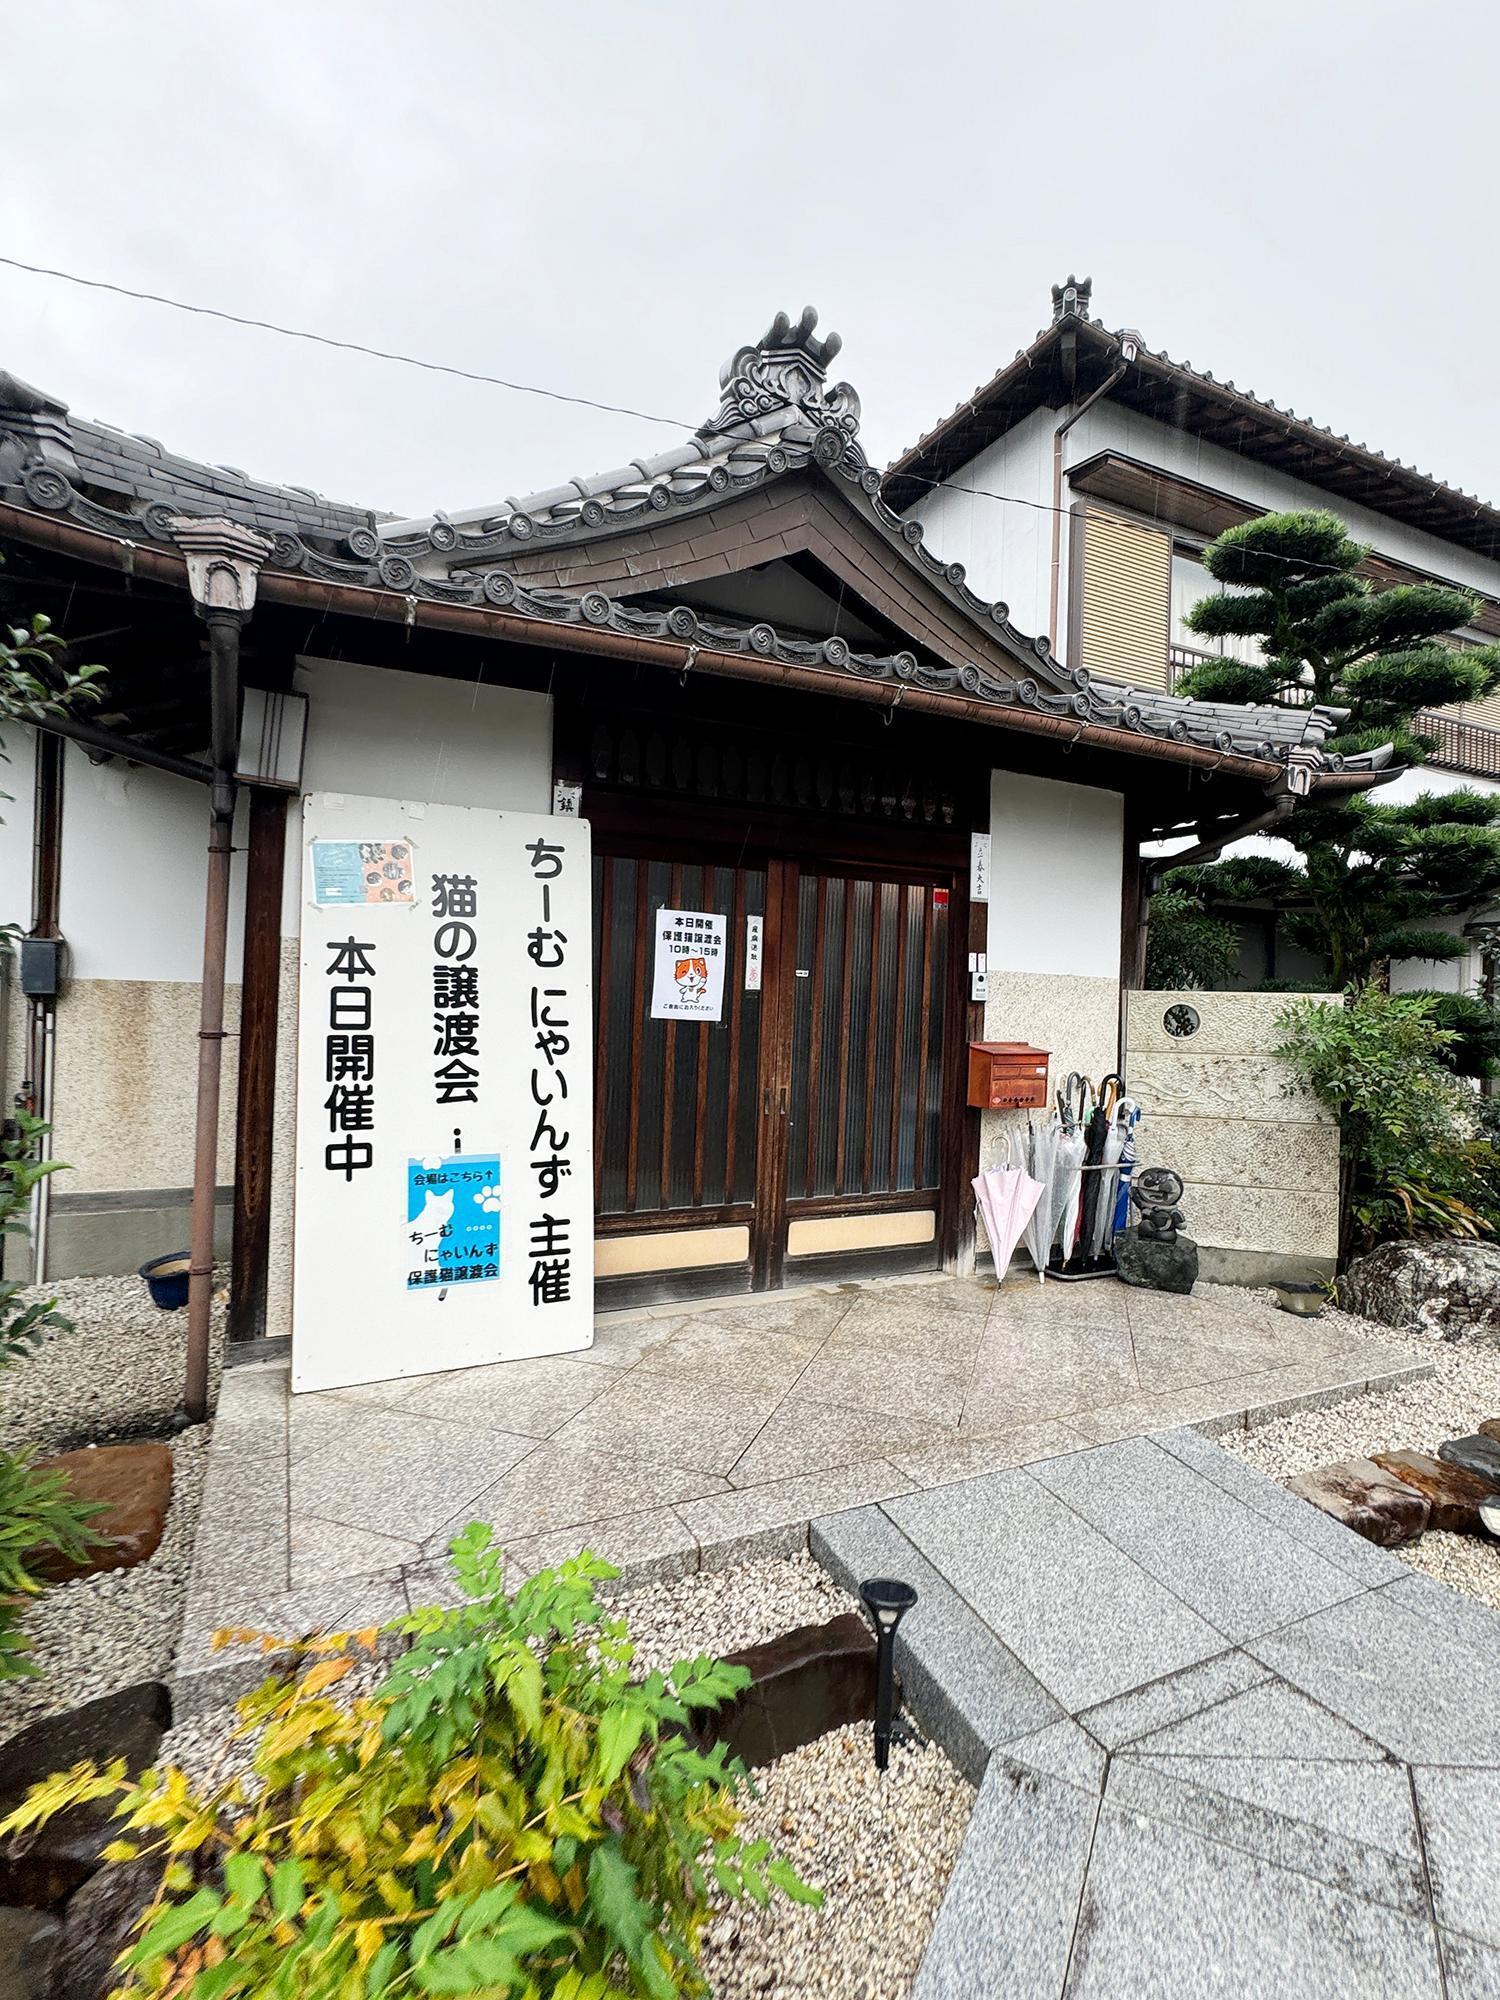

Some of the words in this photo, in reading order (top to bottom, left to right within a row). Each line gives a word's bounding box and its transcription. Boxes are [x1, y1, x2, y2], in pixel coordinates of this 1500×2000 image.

[525, 837, 568, 968] ちーむ
[674, 916, 713, 930] 本日開催
[662, 930, 722, 946] 保護猫譲渡会
[431, 874, 480, 1104] 猫の譲渡会
[323, 935, 377, 1183] 本日開催中
[529, 986, 572, 1199] にゃいんず
[408, 1223, 454, 1246] ちーむ
[424, 1242, 499, 1263] にゃいんず
[528, 1212, 571, 1307] 主催
[407, 1262, 499, 1286] 保護猫譲渡会
